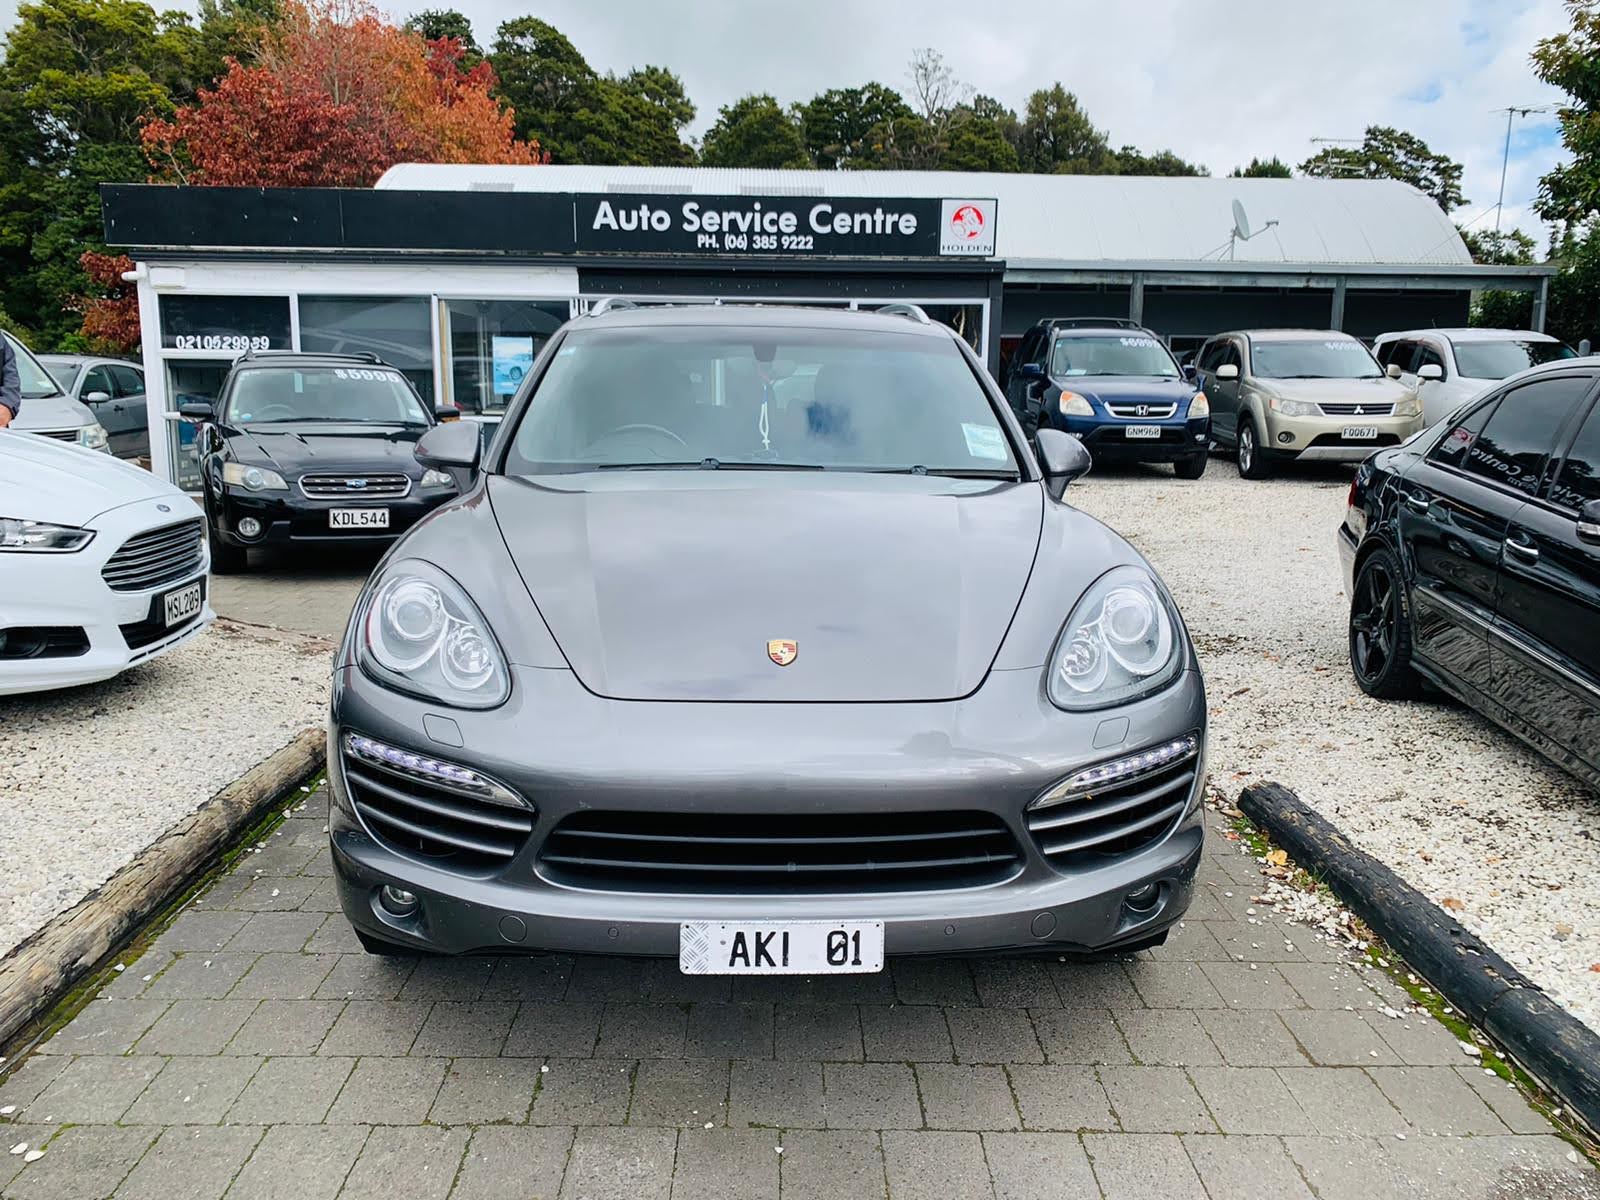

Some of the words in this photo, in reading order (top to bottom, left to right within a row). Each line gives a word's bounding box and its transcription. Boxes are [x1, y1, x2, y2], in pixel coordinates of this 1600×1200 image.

[592, 200, 671, 232] Auto
[682, 201, 798, 233] Service
[809, 203, 918, 235] Centre
[697, 233, 720, 248] PH.
[724, 233, 748, 251] (06)
[752, 234, 778, 249] 385
[781, 235, 814, 250] 9222
[332, 511, 387, 525] KDL544
[728, 931, 790, 967] AKI
[826, 930, 862, 967] 01
